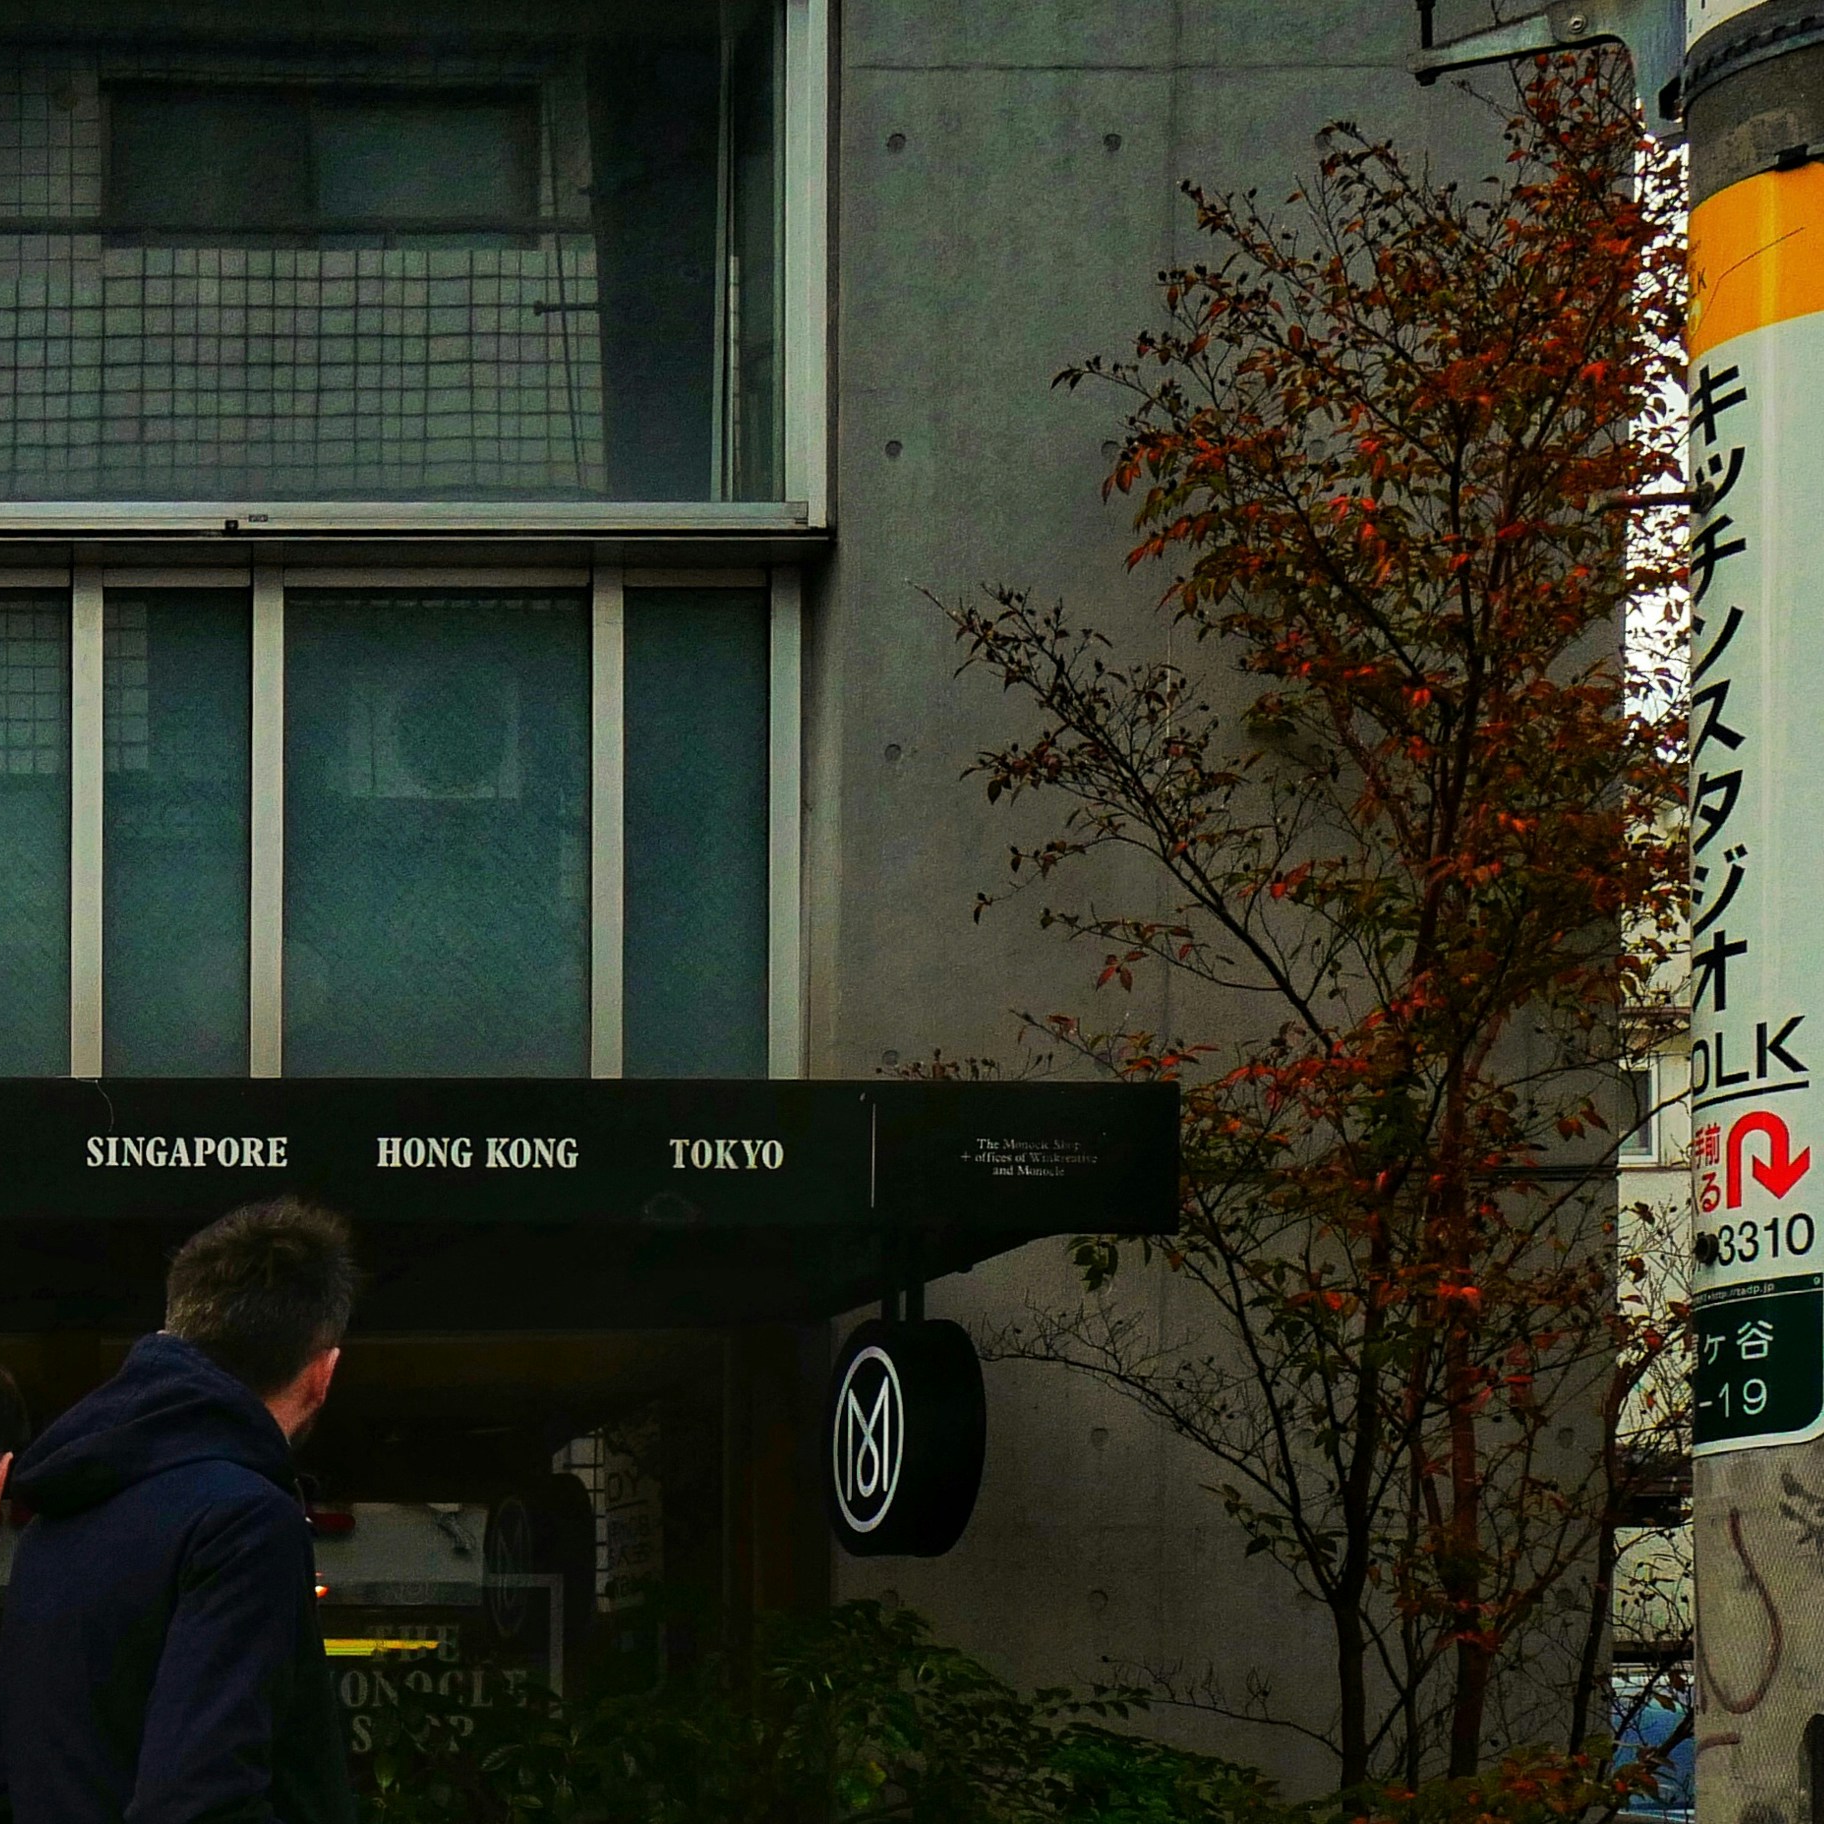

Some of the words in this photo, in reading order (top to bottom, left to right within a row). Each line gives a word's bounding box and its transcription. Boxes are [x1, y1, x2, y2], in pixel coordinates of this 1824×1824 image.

[86, 1136, 288, 1168] SINGAPORE
[376, 1137, 474, 1168] HONG
[485, 1137, 579, 1169] KONG
[669, 1138, 784, 1170] TOKYO
[974, 1151, 1012, 1163] offices
[1014, 1151, 1026, 1163] of
[976, 1137, 1000, 1150] The
[992, 1165, 1014, 1176] and
[1016, 1164, 1065, 1177] Monocle
[329, 1669, 528, 1708] ONOCLE
